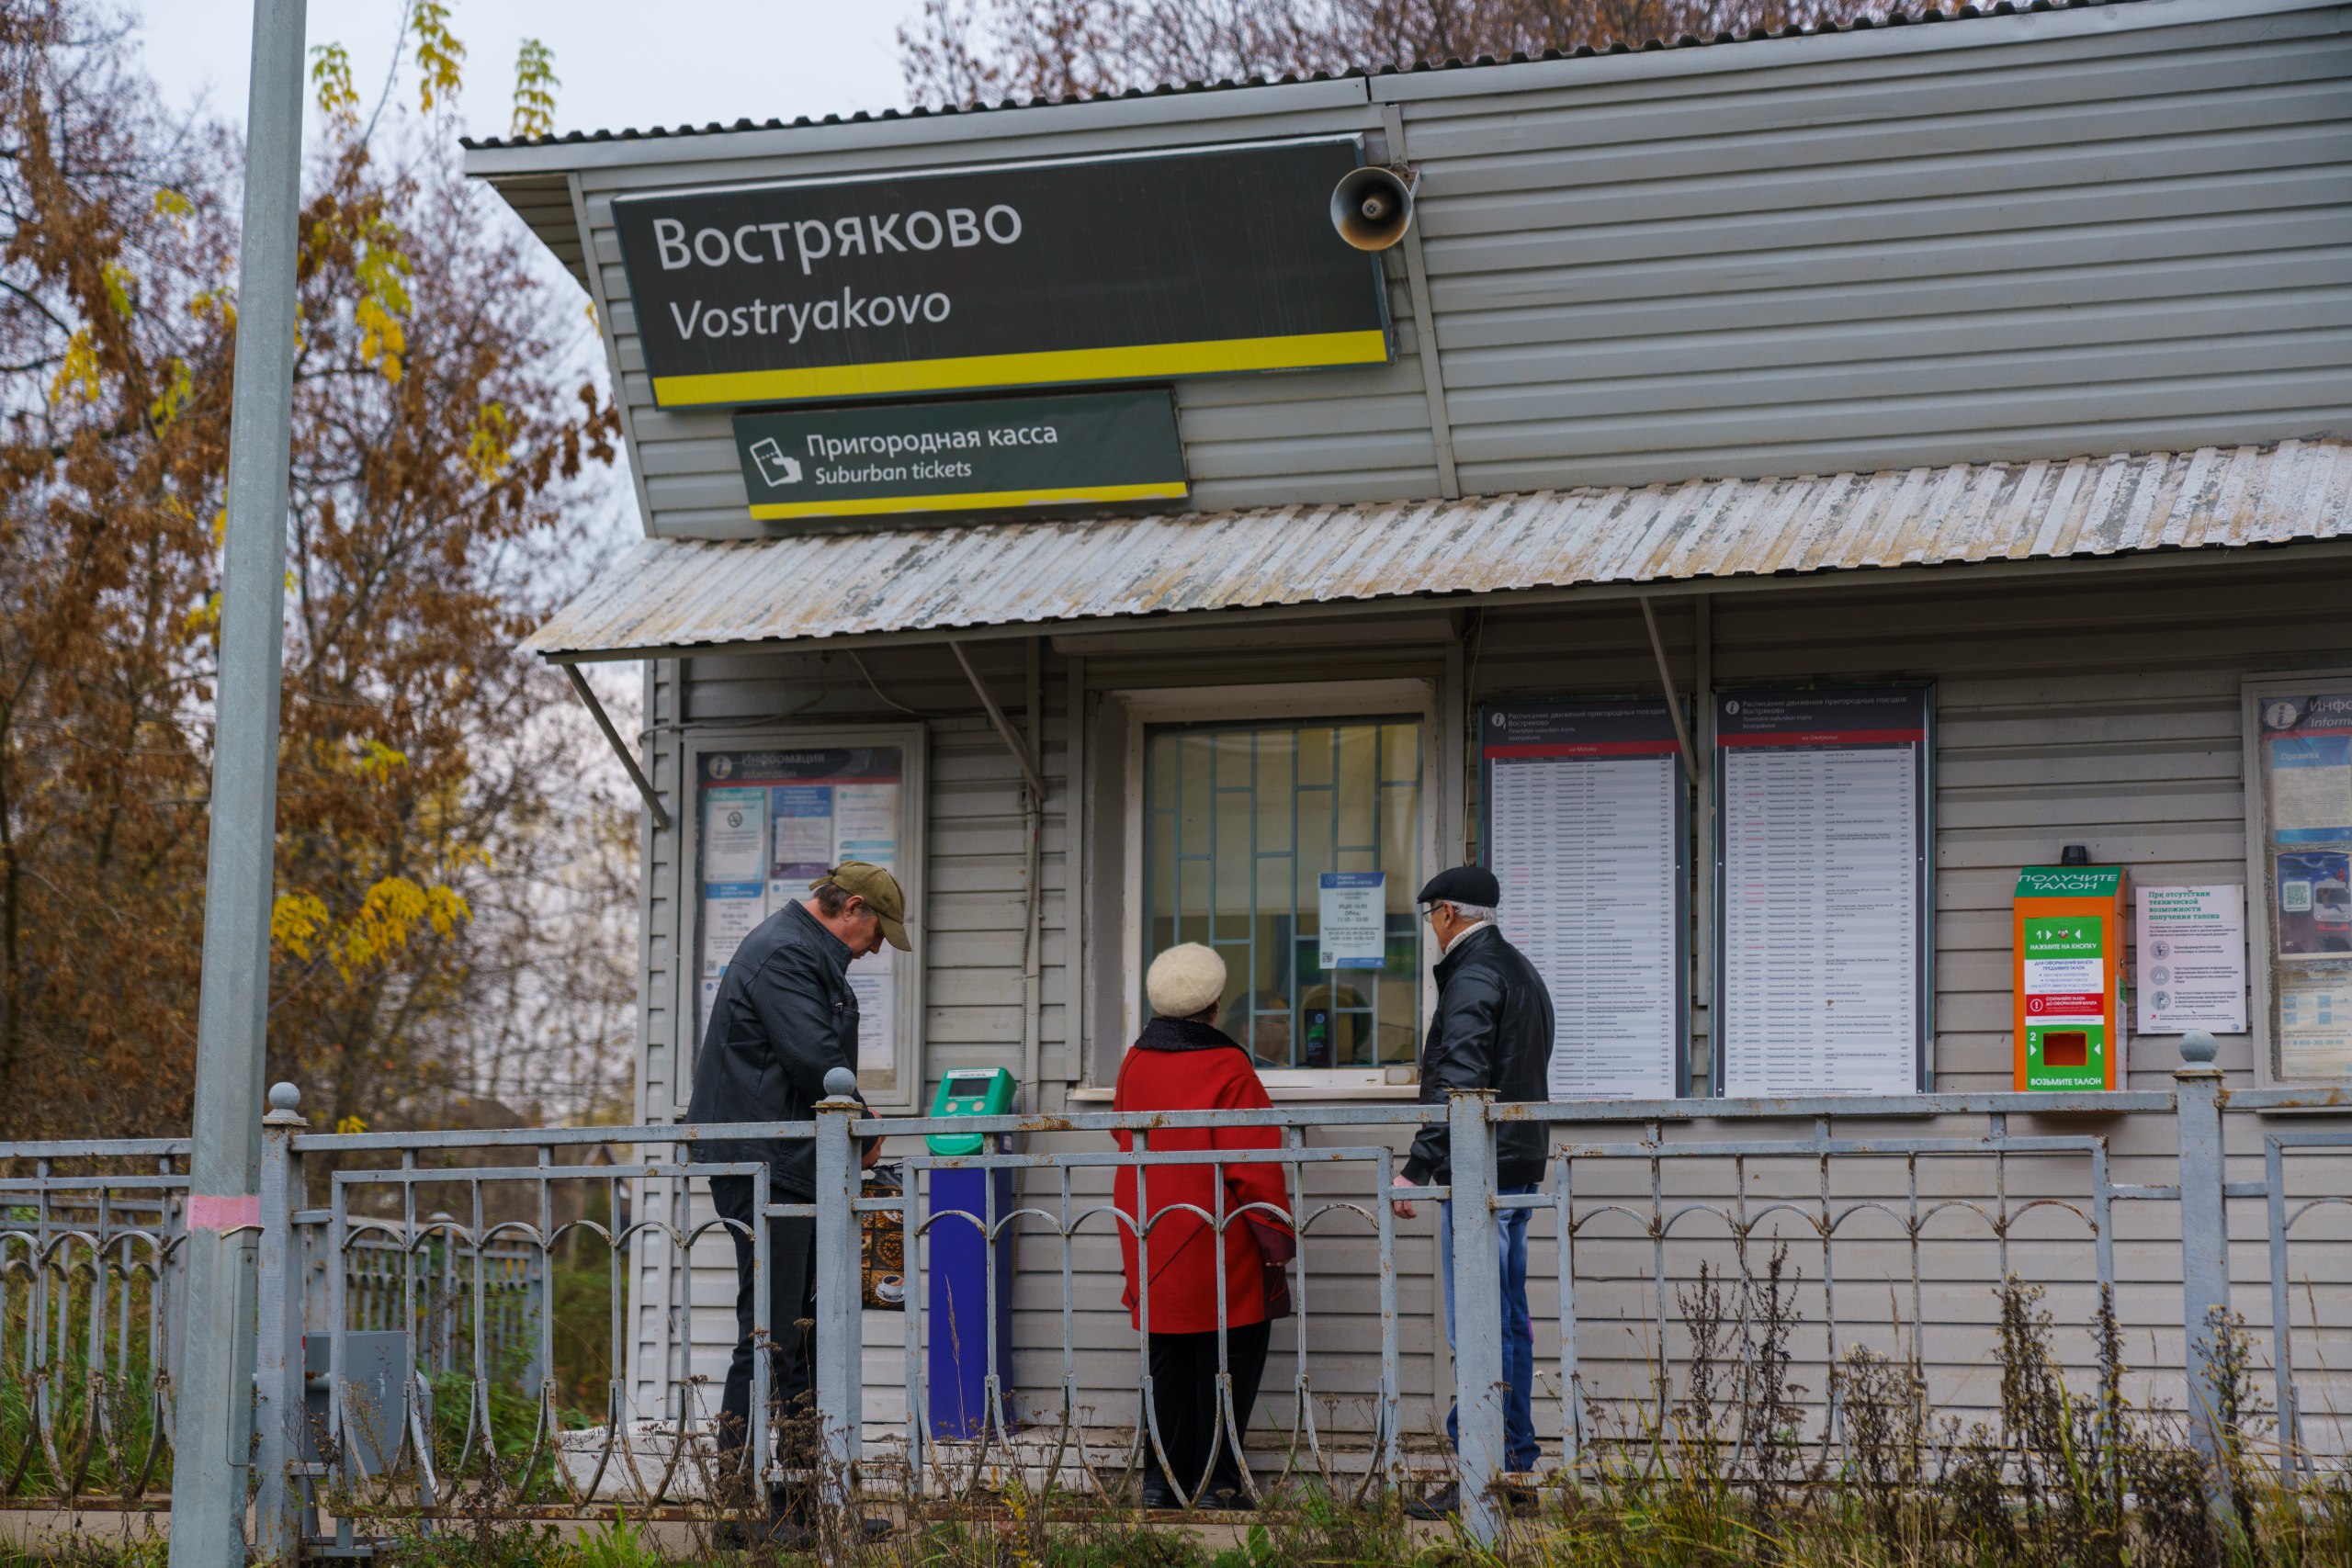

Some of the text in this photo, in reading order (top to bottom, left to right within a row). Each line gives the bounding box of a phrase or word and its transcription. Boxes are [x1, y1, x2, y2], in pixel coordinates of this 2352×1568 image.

[652, 203, 1023, 274] Востряково
[669, 287, 952, 344] Vostryakovo
[806, 423, 1058, 460] Пригородная касса
[815, 458, 972, 485] Suburban tickets
[1743, 700, 1784, 708] Расписание
[1825, 697, 1874, 705] пригородных
[1509, 707, 1667, 720] Расписание движения пригородных поездов
[1743, 707, 1785, 716] Востряково
[1509, 719, 1549, 728] Востряково
[741, 752, 826, 767] Информация
[2280, 752, 2320, 761] Правила
[2018, 874, 2118, 883] ПОЛУЧИТЕ
[2033, 882, 2098, 890] ТАЛОН
[2149, 891, 2165, 899] При
[2036, 931, 2041, 939] 1
[2030, 1032, 2037, 1042] 2
[2030, 1077, 2102, 1087] ВОЗЬМИТЕ ТАЛОН
